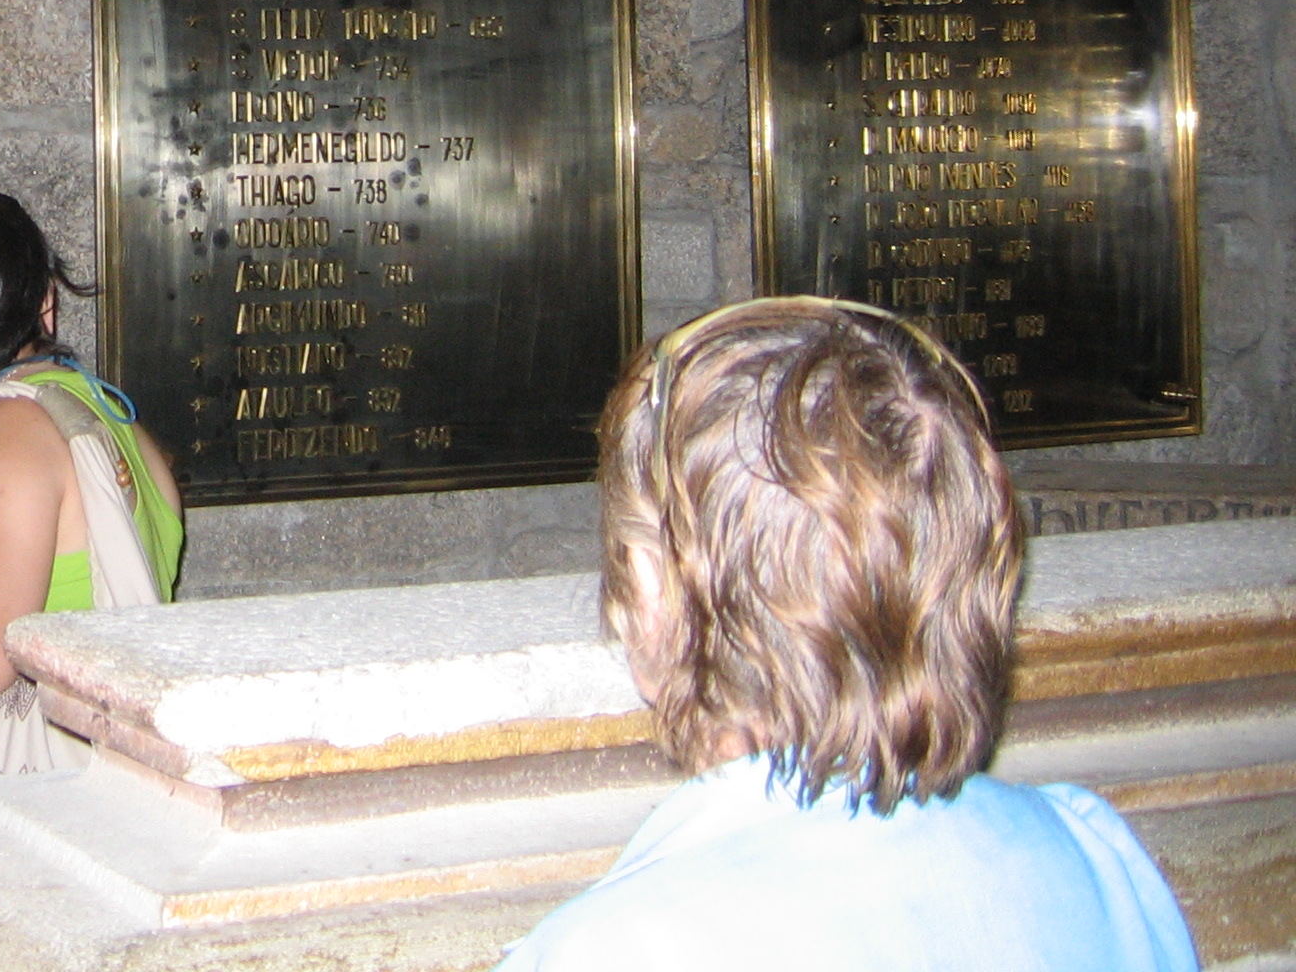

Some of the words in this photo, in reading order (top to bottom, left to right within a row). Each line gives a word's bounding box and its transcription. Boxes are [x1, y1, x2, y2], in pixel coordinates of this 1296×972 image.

[233, 131, 407, 165] HERMENEGILDO
[441, 136, 475, 162] 737
[235, 174, 316, 208] THIAGO
[354, 178, 388, 205] 738
[367, 219, 401, 246] 740
